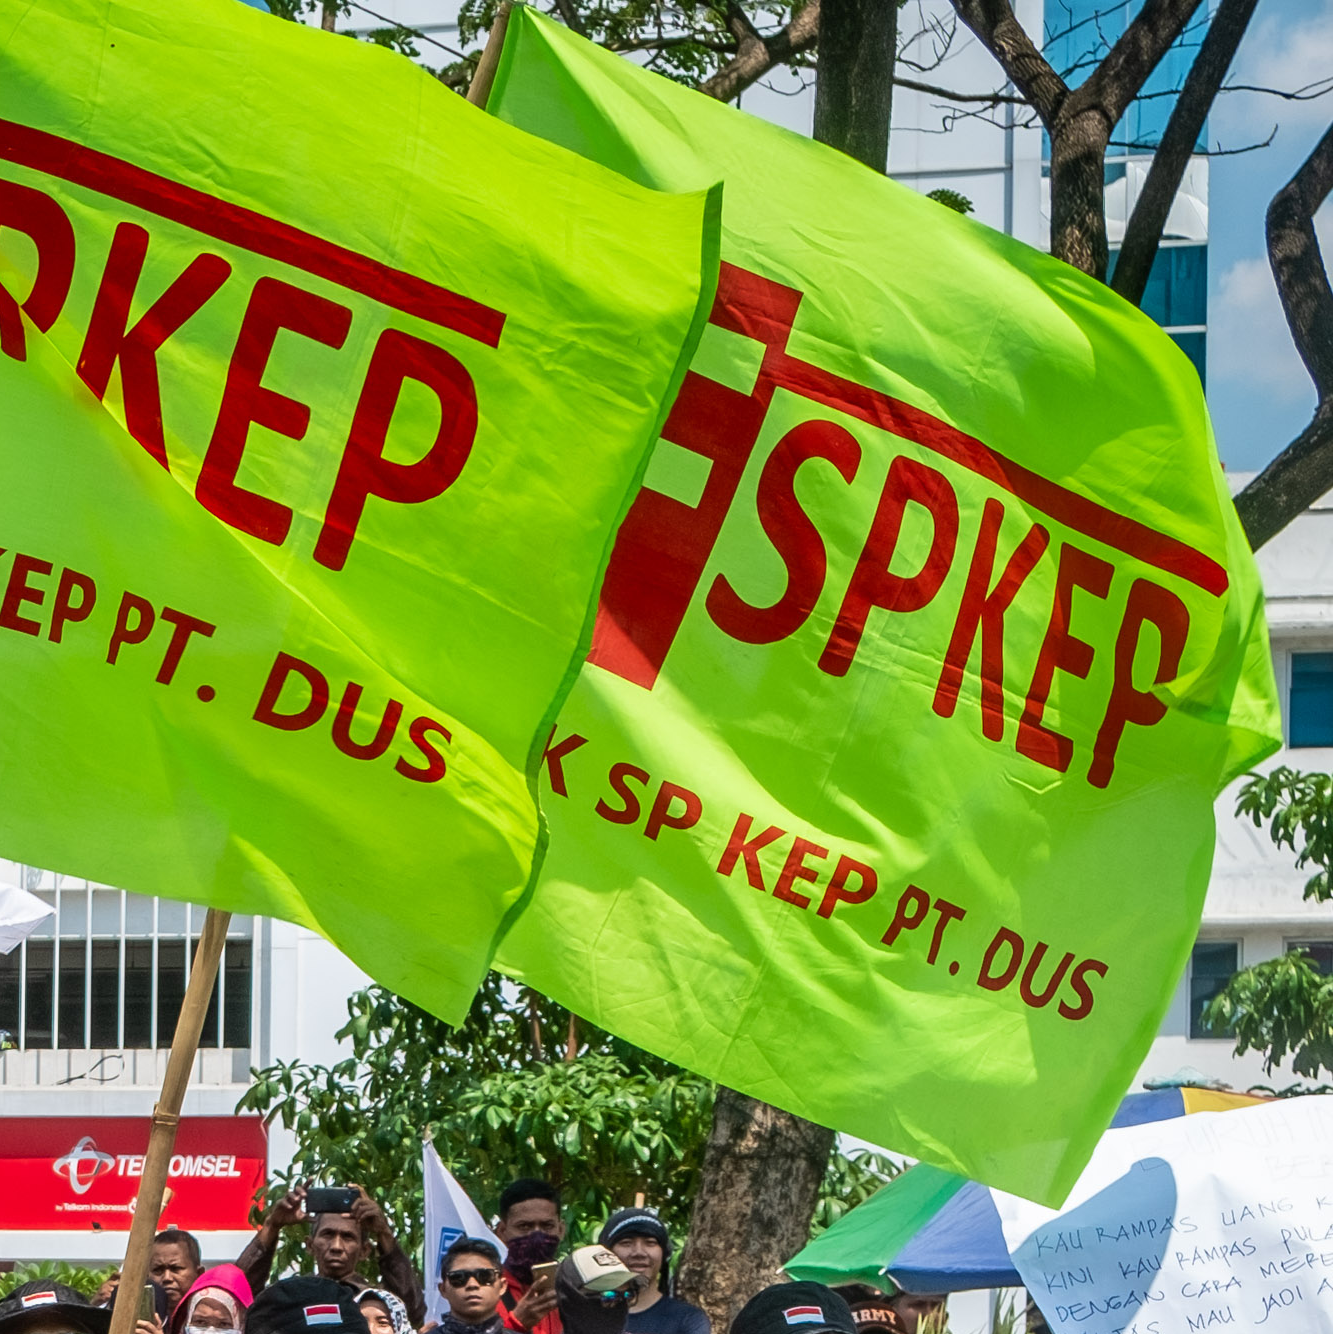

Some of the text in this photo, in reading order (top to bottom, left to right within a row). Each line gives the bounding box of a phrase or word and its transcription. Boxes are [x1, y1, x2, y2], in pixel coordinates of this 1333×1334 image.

[705, 418, 1191, 790] SPKEP
[107, 591, 217, 703] PT.
[252, 650, 452, 785] DUS
[594, 760, 703, 842] SP
[716, 812, 879, 920] KEP
[880, 884, 967, 976] PT.
[976, 926, 1108, 1022] DUS
[116, 1154, 242, 1178] TEOMSEL
[64, 1202, 91, 1212] Telkom
[1034, 1231, 1084, 1259] KAU
[1096, 1216, 1200, 1244] RAMPAS
[1221, 1197, 1294, 1227] UANG
[1043, 1266, 1096, 1295] KINI
[1118, 1256, 1164, 1280] KAU
[1176, 1237, 1258, 1271] RAMPAS
[1056, 1290, 1165, 1323] DENGAN
[1186, 1306, 1235, 1333] MAU
[1254, 1286, 1304, 1325] JADI
